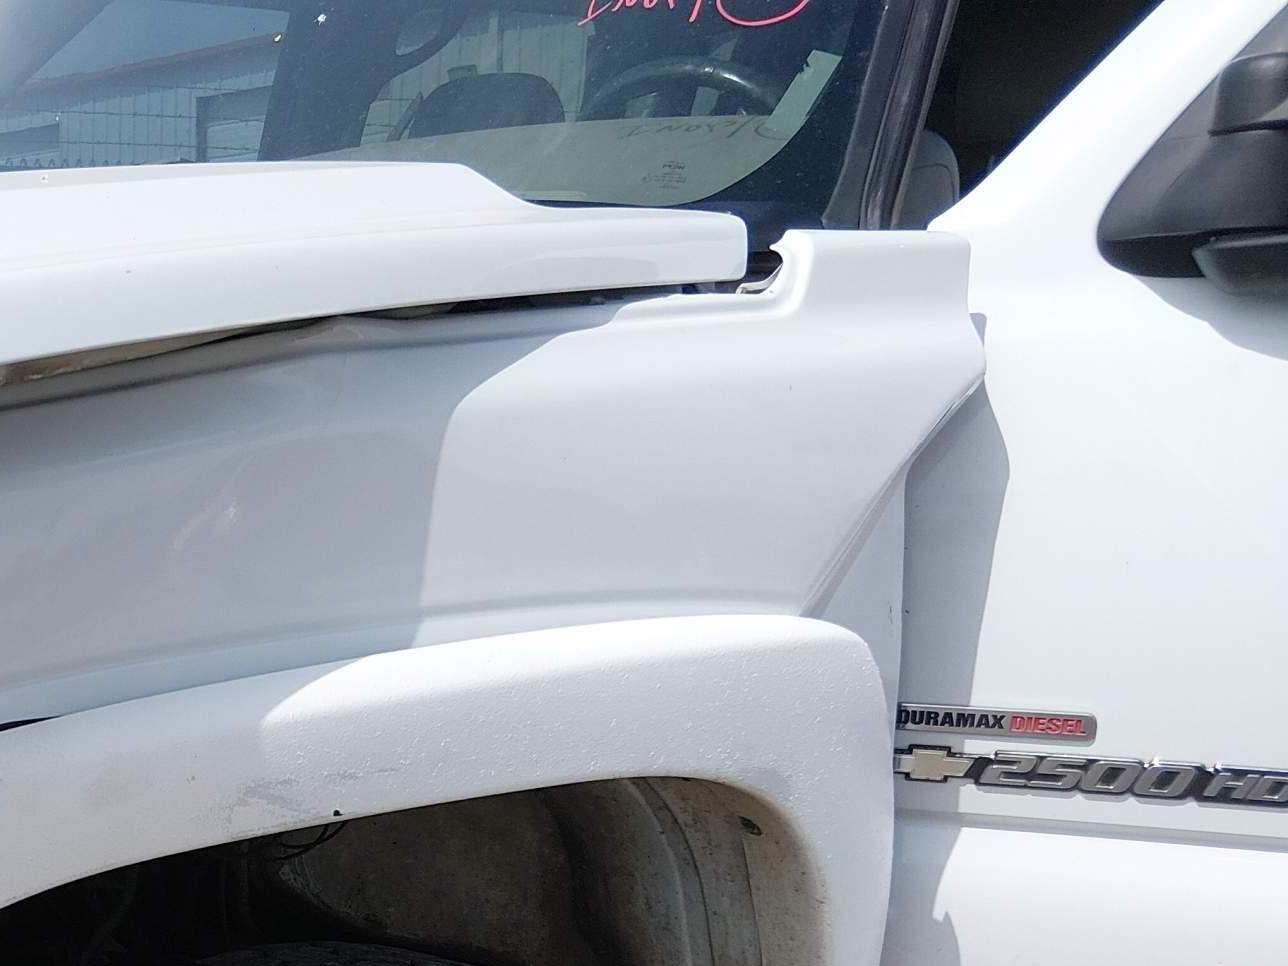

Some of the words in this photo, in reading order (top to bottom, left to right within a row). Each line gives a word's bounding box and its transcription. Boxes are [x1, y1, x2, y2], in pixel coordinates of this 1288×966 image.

[896, 709, 1006, 730] DURAMAX
[1010, 715, 1087, 737] DIESEL
[978, 753, 1196, 799] 2500
[1203, 771, 1288, 804] HD
